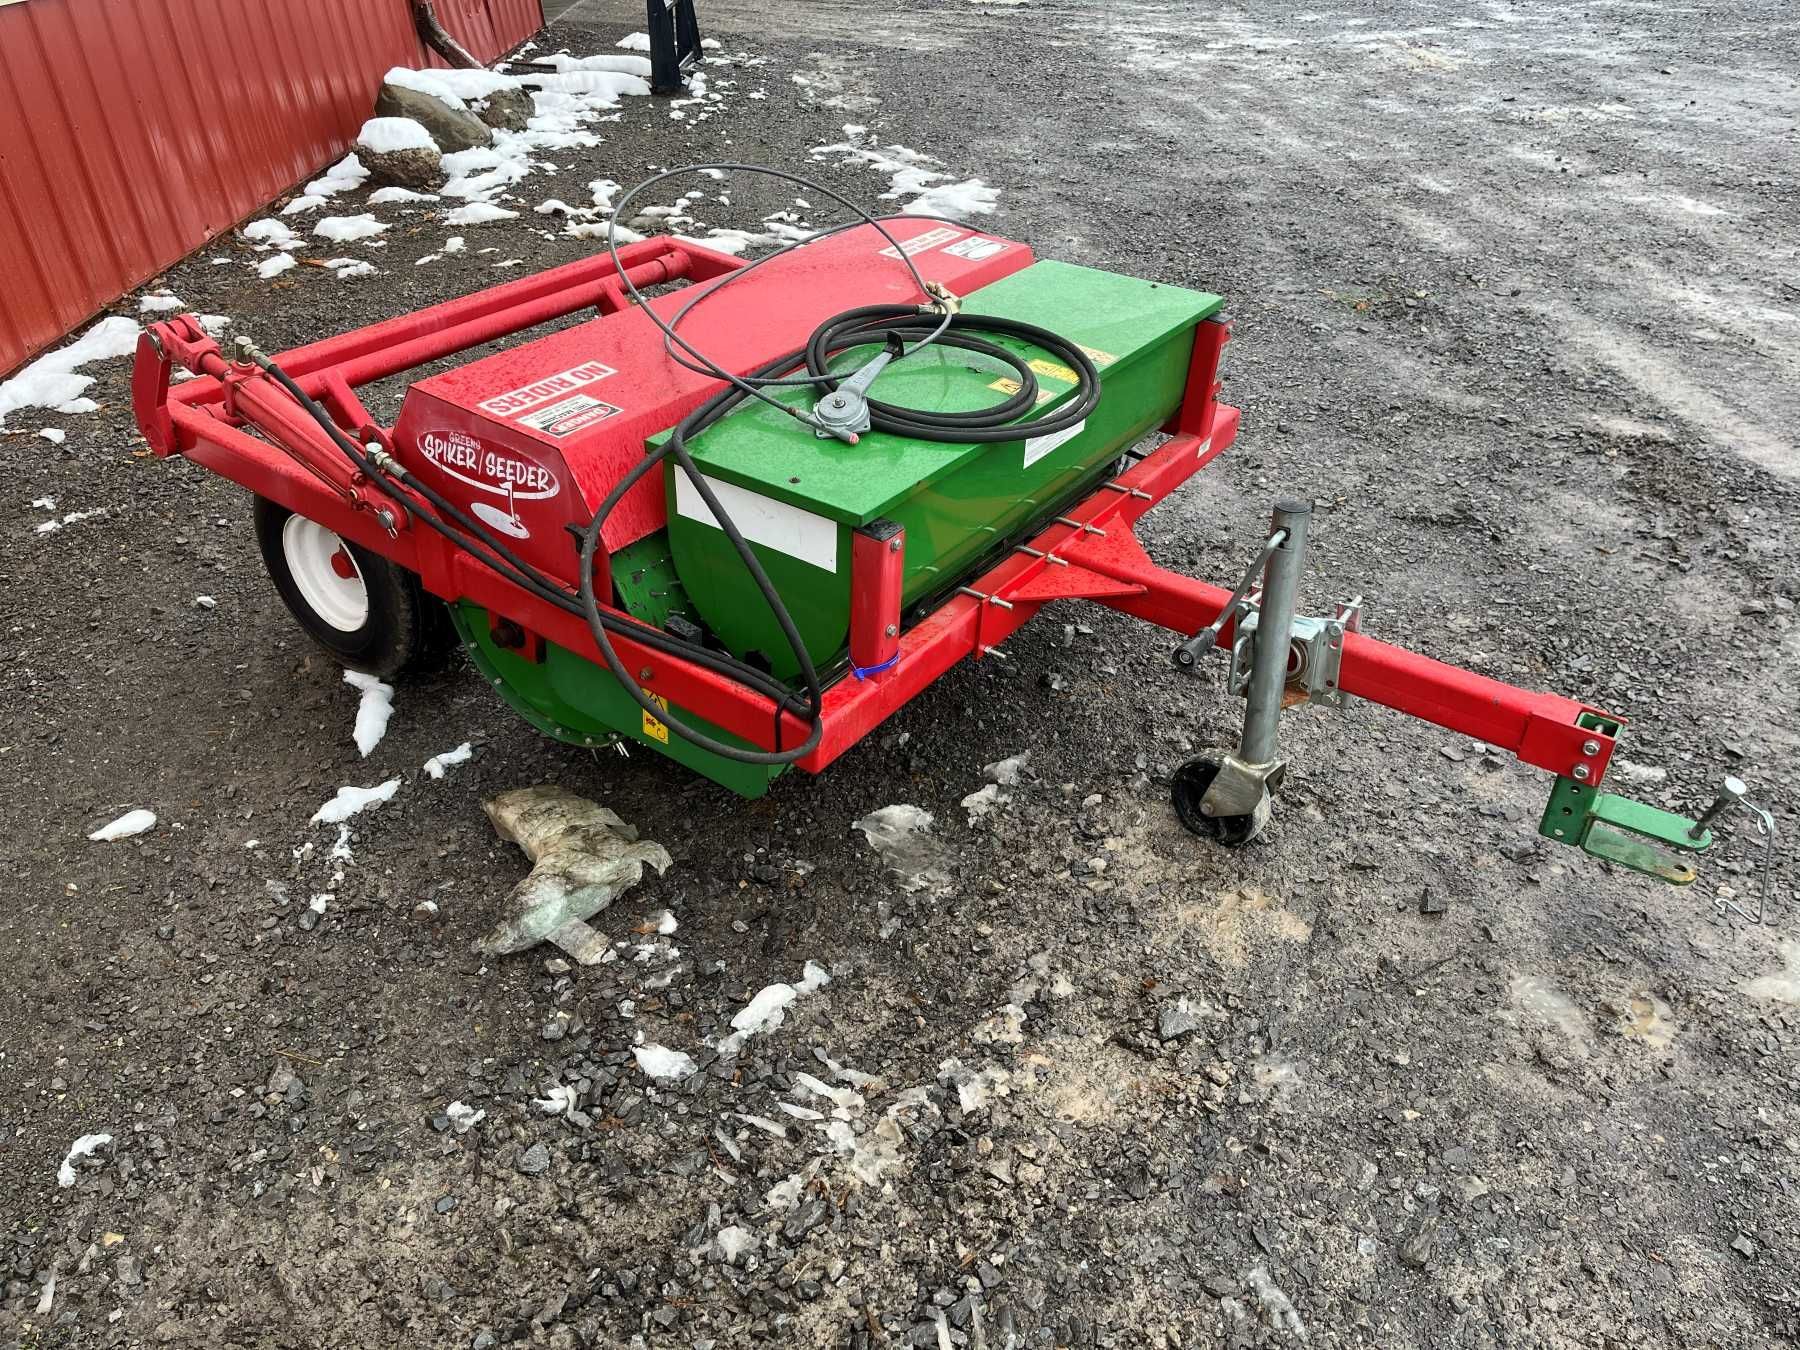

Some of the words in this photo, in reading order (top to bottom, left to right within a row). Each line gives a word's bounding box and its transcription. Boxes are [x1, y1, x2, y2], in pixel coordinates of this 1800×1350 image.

[570, 364, 609, 380] NO
[486, 377, 576, 412] RIDERS
[552, 406, 606, 432] DANGER
